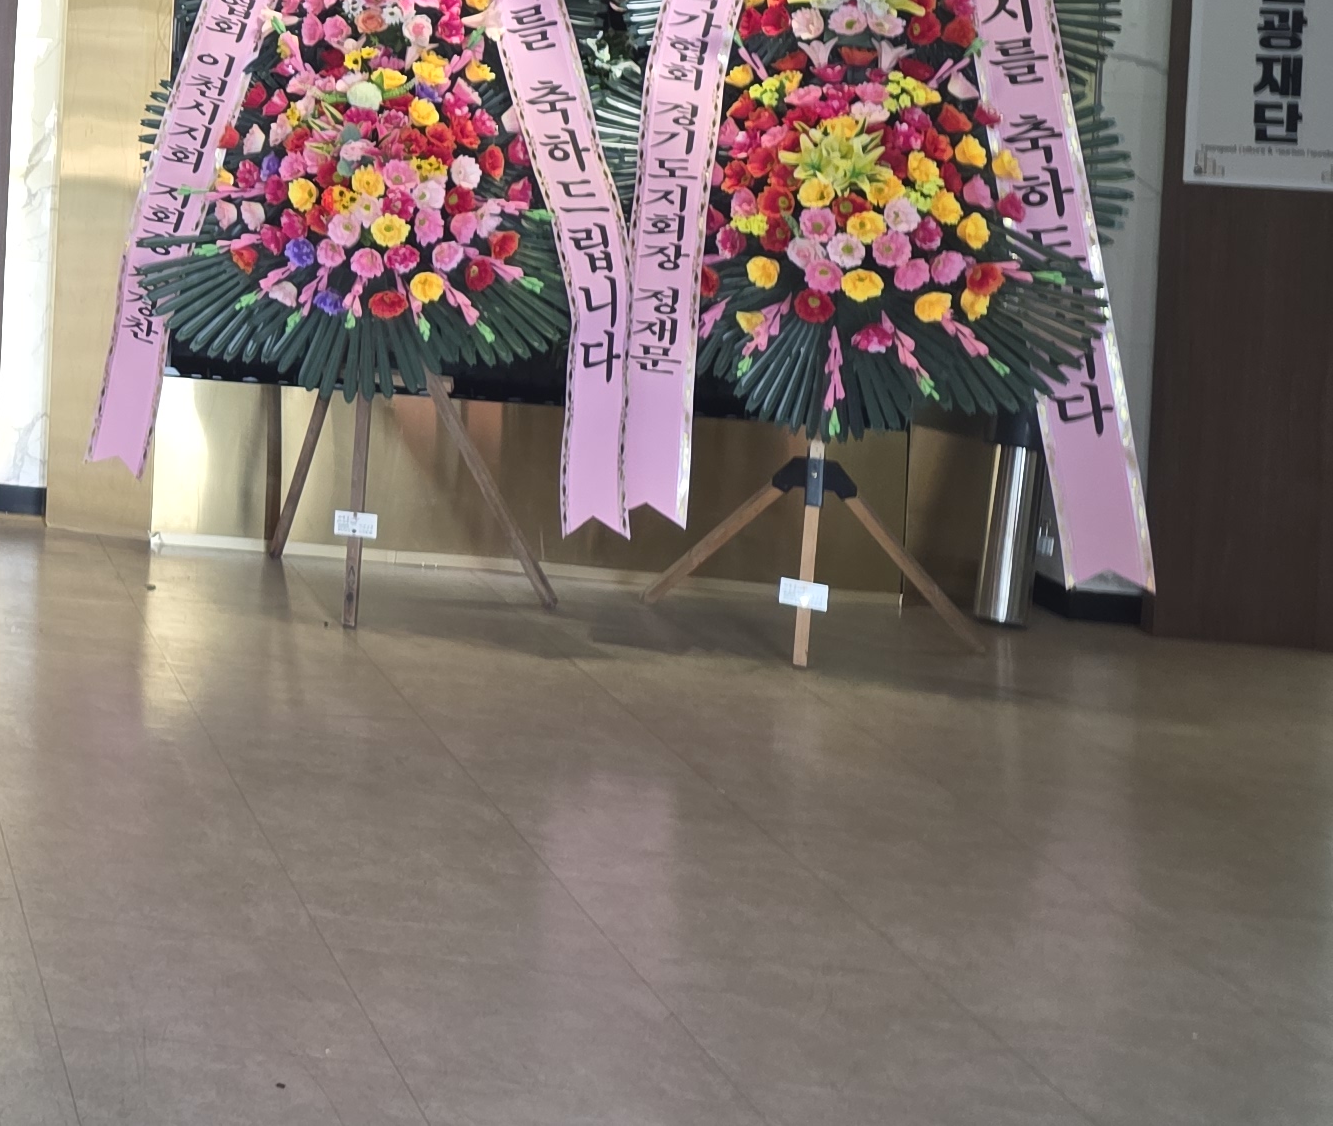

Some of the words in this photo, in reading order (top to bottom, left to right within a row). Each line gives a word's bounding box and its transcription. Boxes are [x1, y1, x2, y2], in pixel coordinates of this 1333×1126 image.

[162, 53, 236, 174] 이천시지회
[638, 101, 699, 272] 경기도지회장
[526, 80, 622, 384] 축하드립니다
[629, 286, 682, 376] 정재문
